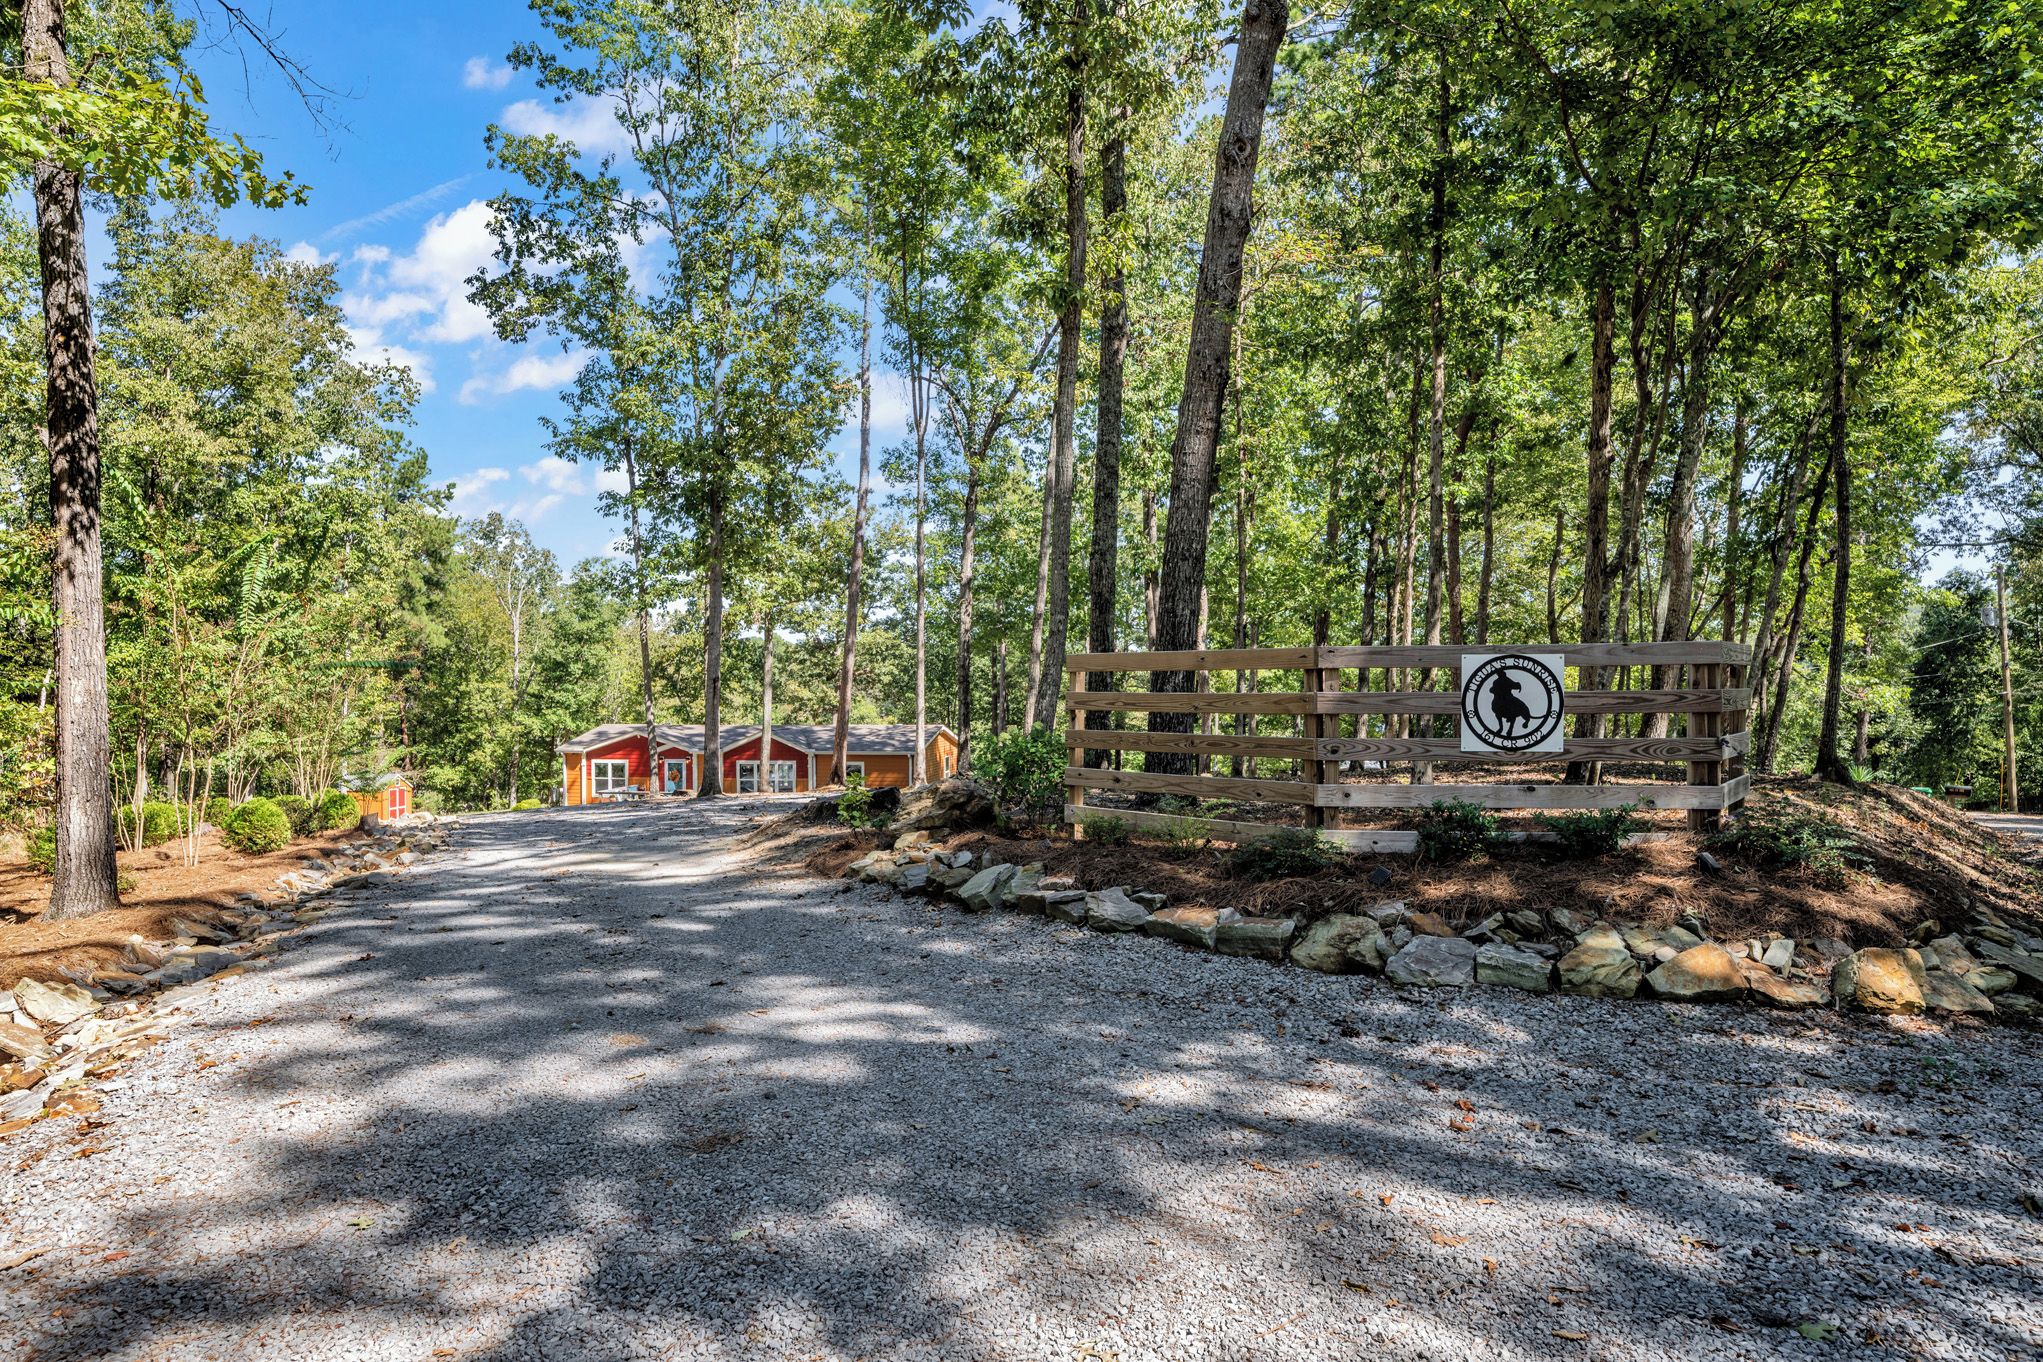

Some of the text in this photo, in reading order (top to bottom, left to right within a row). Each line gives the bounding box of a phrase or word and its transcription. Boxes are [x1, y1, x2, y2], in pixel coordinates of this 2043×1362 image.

[1513, 657, 1557, 694] SUNRISE
[1480, 729, 1545, 748] 161 CR 902
